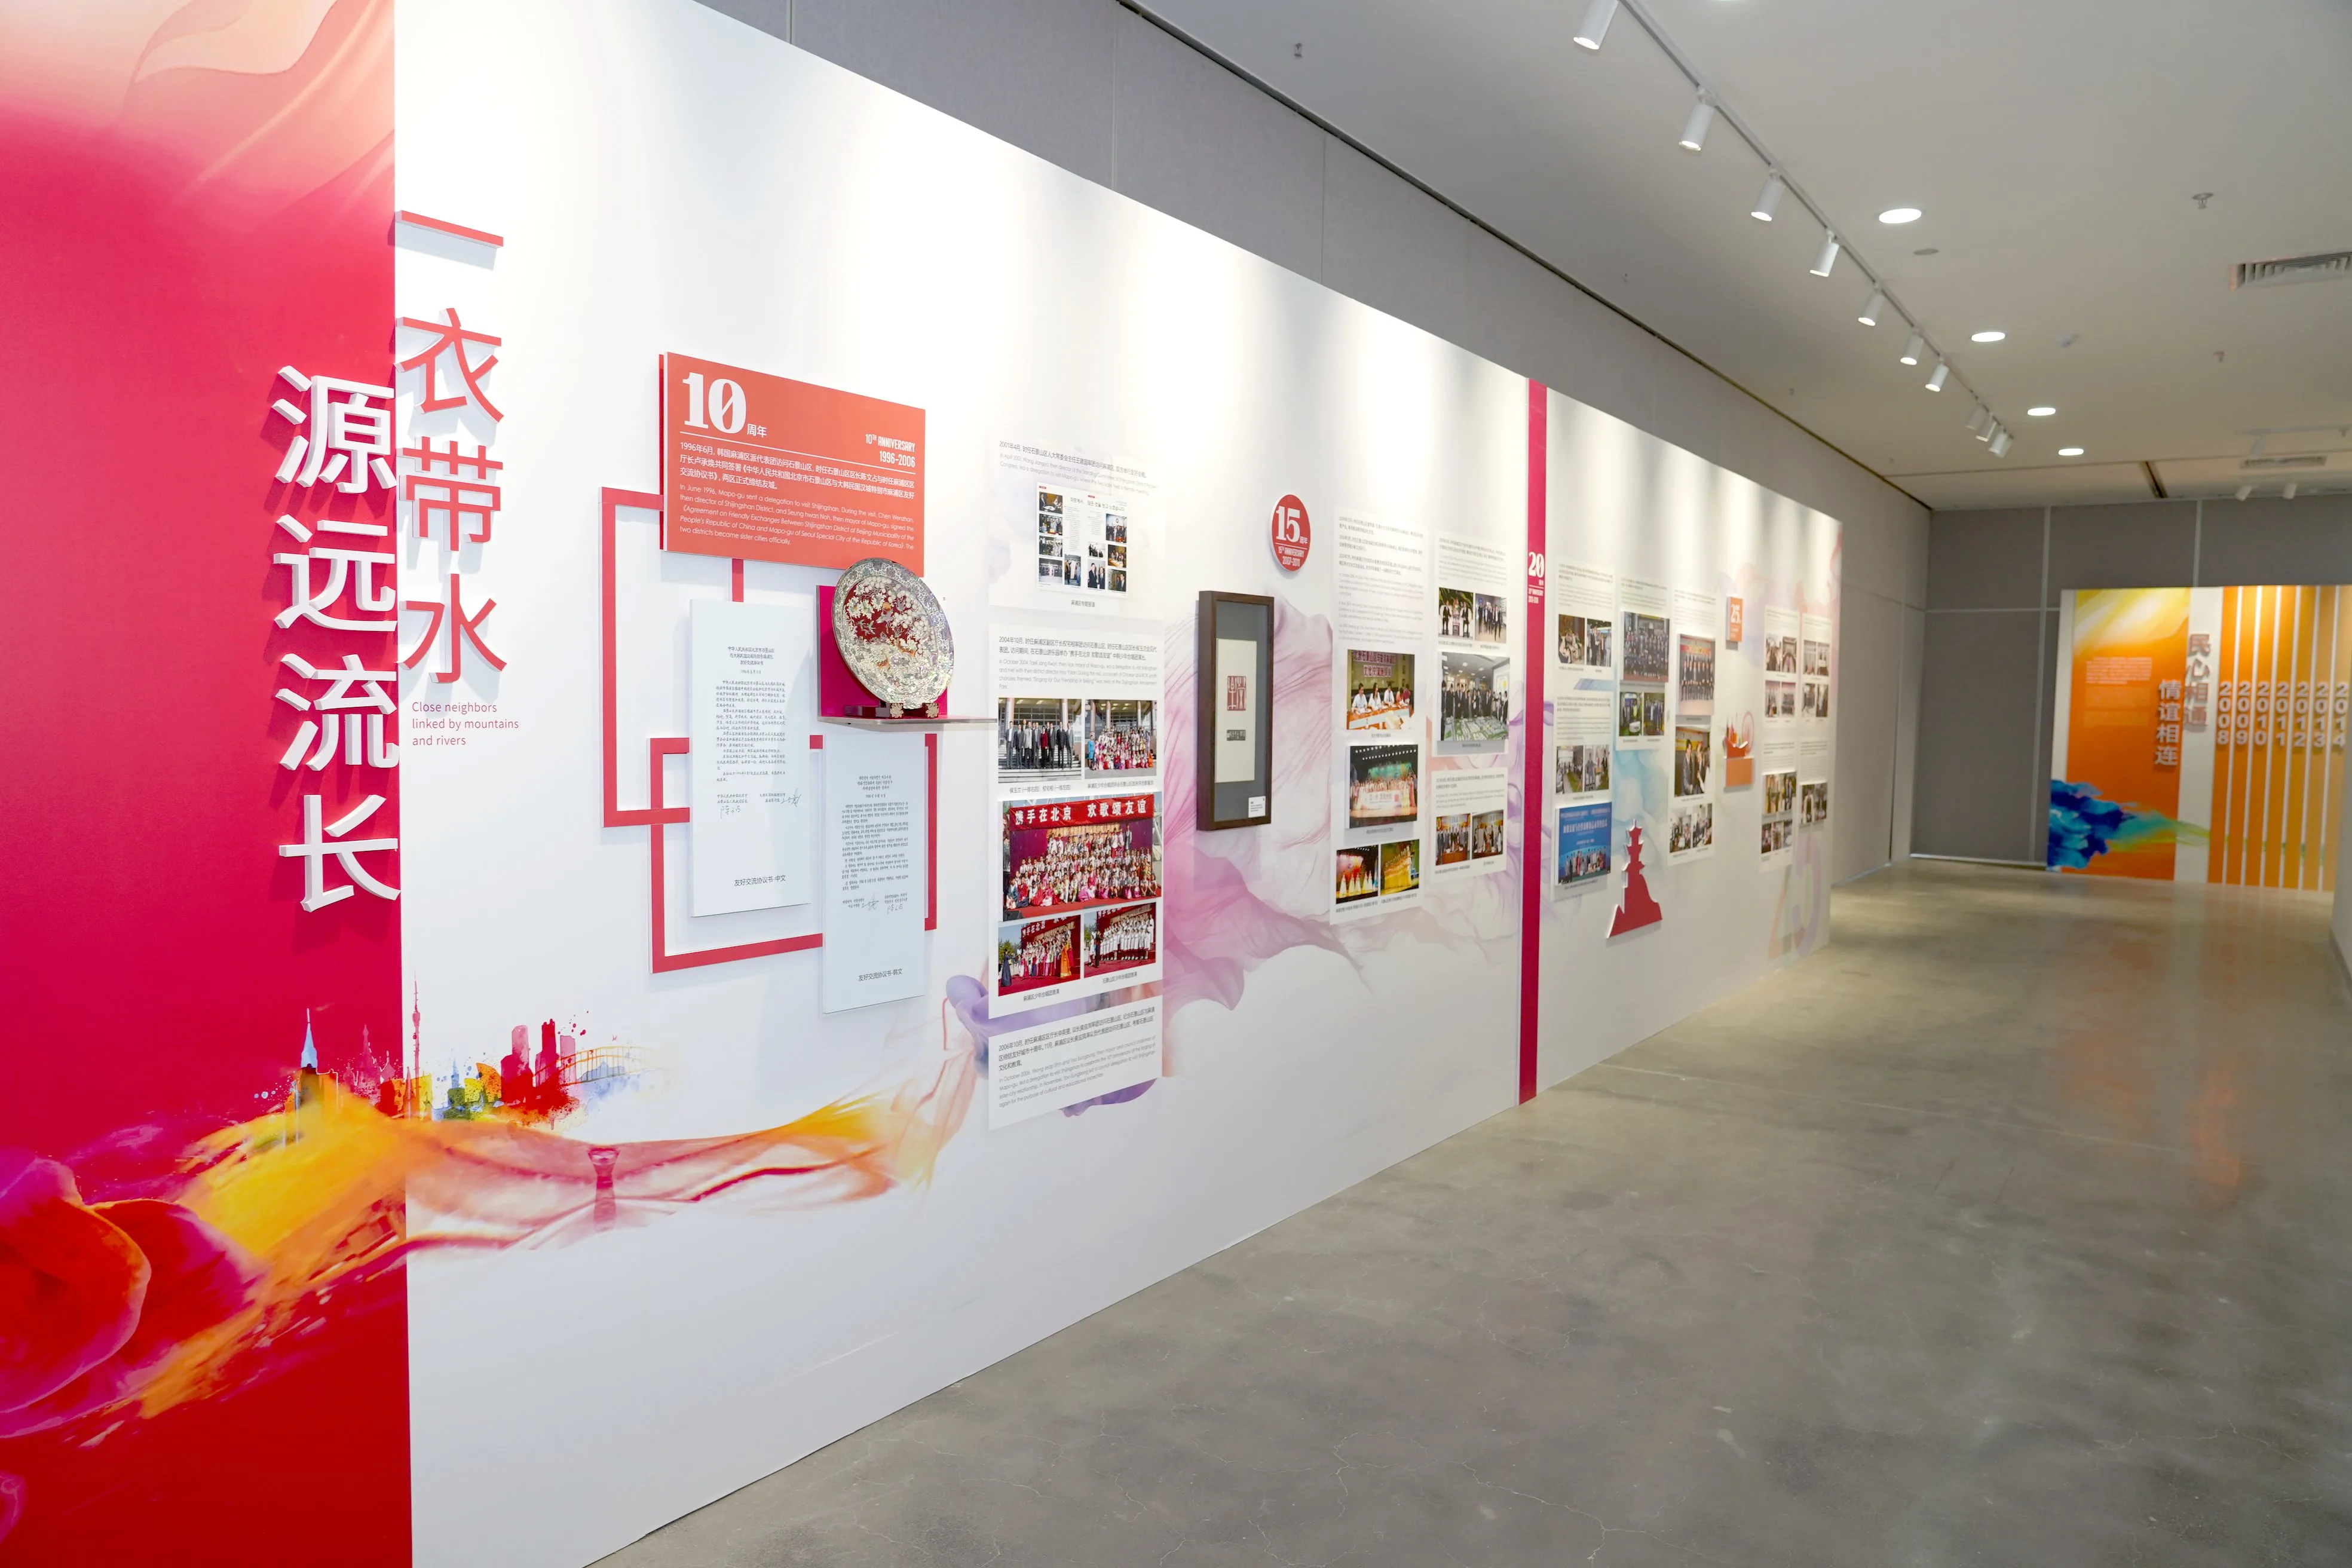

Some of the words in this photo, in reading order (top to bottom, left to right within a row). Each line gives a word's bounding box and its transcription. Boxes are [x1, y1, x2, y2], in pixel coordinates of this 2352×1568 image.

[395, 210, 506, 683] 一衣带水
[878, 436, 915, 452] ANNIVERSARY
[880, 451, 915, 467] 1996-2006
[718, 489, 745, 499] Mapo-gu
[765, 496, 793, 504] delegation
[811, 503, 840, 512] Shijingshan.
[841, 507, 857, 516] During
[724, 500, 754, 509] Shijingshan
[788, 509, 803, 517] Seung
[692, 527, 713, 535] districts
[715, 530, 739, 539] became
[769, 537, 791, 545] officially.
[706, 519, 730, 527] Republic
[768, 527, 794, 535] Mapo-gu
[816, 532, 834, 540] Special
[729, 512, 749, 520] Friendly
[751, 514, 779, 523] Exchanges
[805, 521, 832, 529] Shijingshan
[856, 528, 872, 537] Beijing
[872, 531, 900, 539] Municipality
[1529, 552, 1544, 578] 20
[272, 365, 401, 913] 源远流长
[2184, 634, 2210, 726] 民心相通
[412, 702, 441, 712] Close
[445, 703, 497, 715] neighbors
[2217, 680, 2232, 745] 2008
[2236, 681, 2251, 745] 2009
[2254, 681, 2270, 746] 2010
[2276, 681, 2289, 746] 2011
[2294, 681, 2309, 747] 2012
[2313, 681, 2329, 748] 2013
[2333, 681, 2348, 748] 2014
[412, 719, 445, 728] linked
[449, 719, 461, 730] by
[465, 719, 519, 728] mountains
[2155, 679, 2182, 766] 情谊相连
[412, 735, 432, 745] and
[437, 736, 466, 745] rivers
[1016, 806, 1071, 825] 携手在北京
[1088, 799, 1146, 817] 欢歌颂友谊
